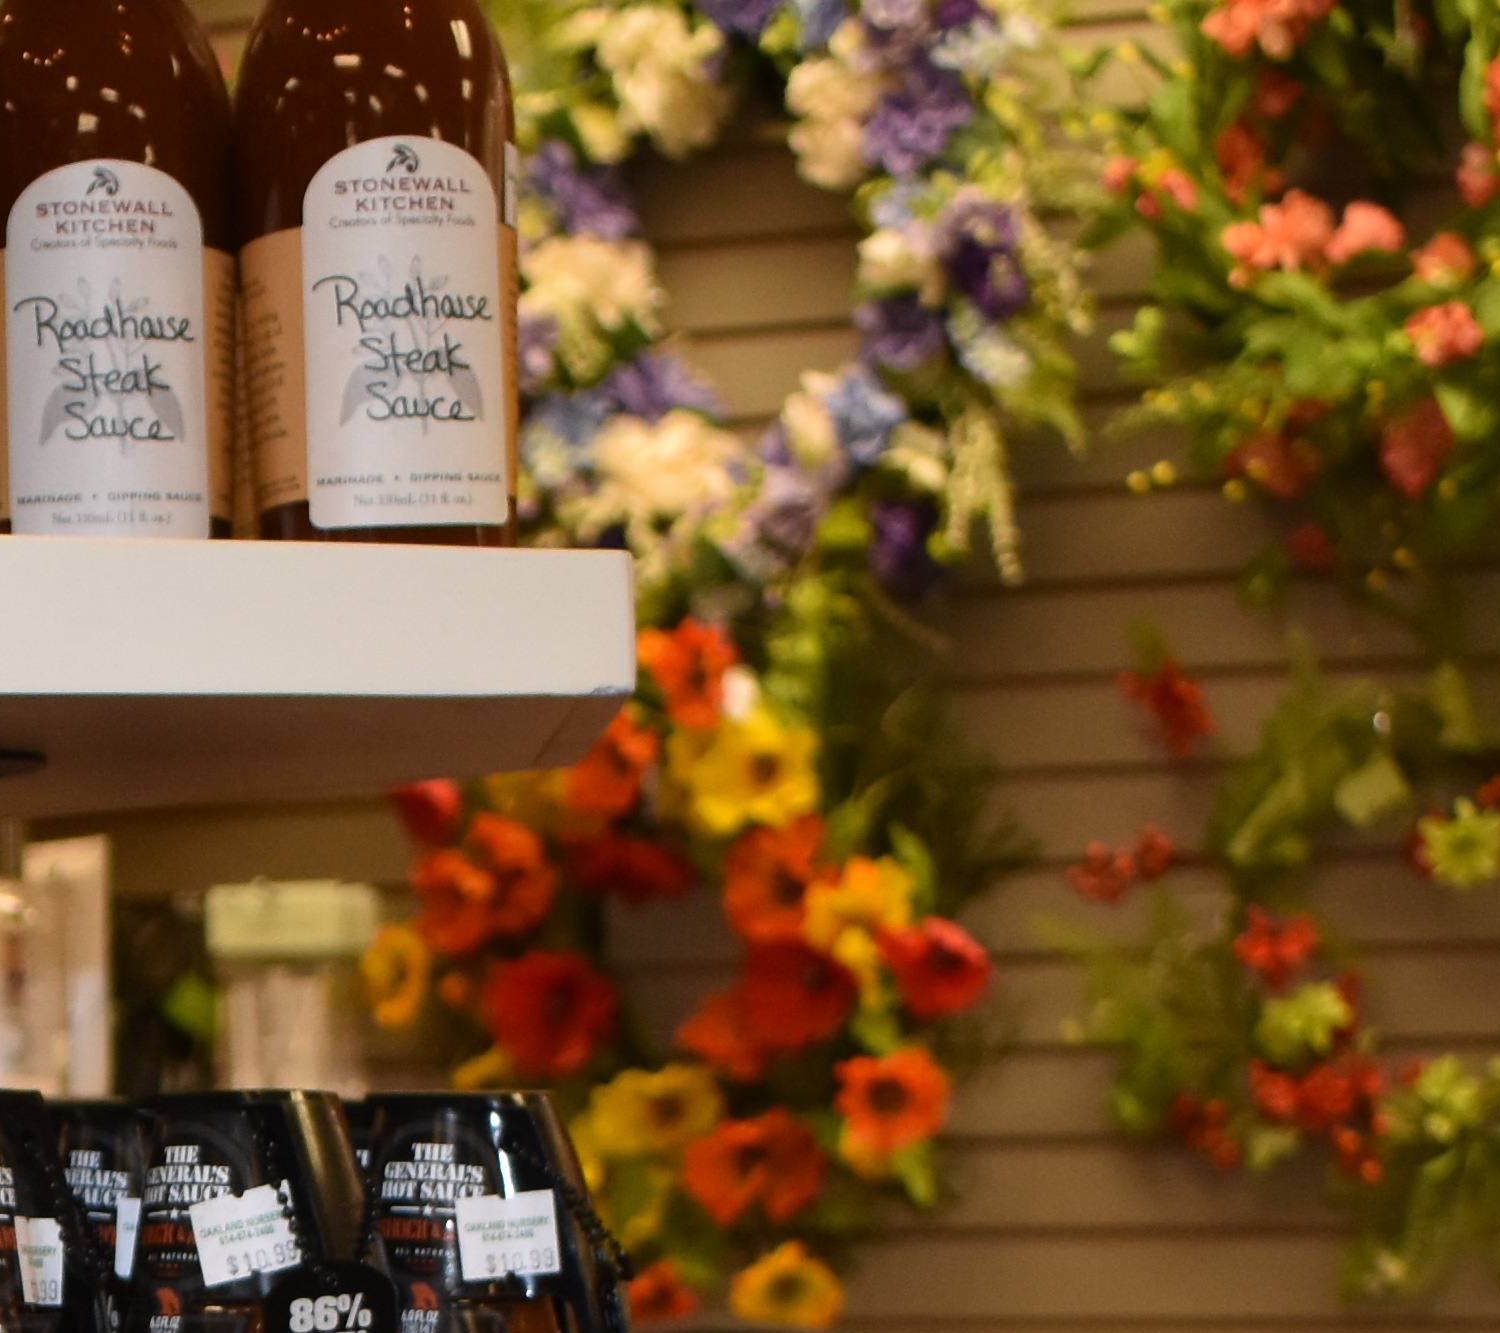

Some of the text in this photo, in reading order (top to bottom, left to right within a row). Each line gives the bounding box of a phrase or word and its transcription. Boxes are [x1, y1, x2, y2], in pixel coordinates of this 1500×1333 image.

[335, 177, 471, 195] STONEWALL
[36, 200, 172, 218] STONEWALL
[355, 195, 454, 212] KITCHEN
[56, 219, 154, 235] KITCHEN
[360, 332, 470, 376] Steak
[60, 353, 170, 397] Steak
[367, 382, 475, 421] Sauce
[65, 401, 174, 440] Sauce
[164, 1145, 199, 1165] THE
[412, 1143, 454, 1162] THE
[382, 1181, 417, 1199] HOT
[289, 1293, 372, 1333] 86%
